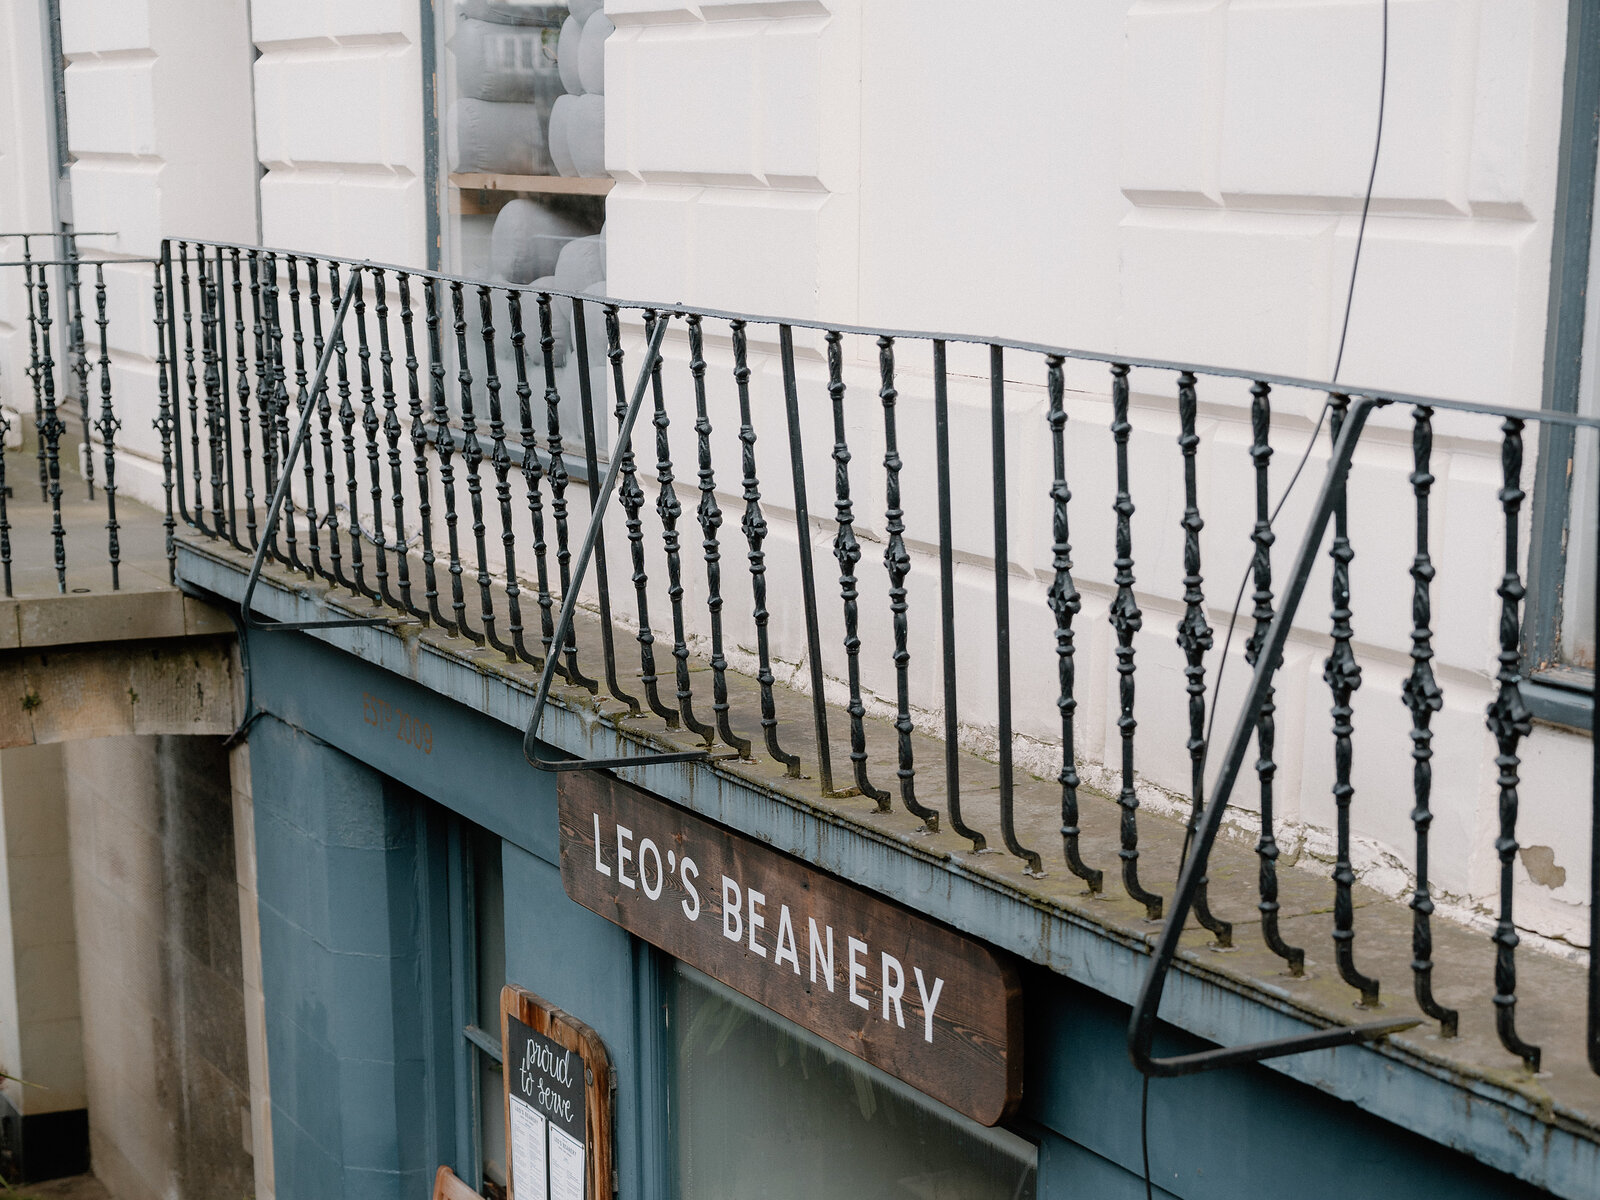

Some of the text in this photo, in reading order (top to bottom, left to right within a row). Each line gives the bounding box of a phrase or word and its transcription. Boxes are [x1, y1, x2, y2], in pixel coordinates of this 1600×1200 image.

[395, 708, 433, 755] 2009
[593, 813, 944, 1043] LEO'S BEANERY
[519, 1057, 574, 1122] to serve
[526, 1038, 572, 1088] proud
